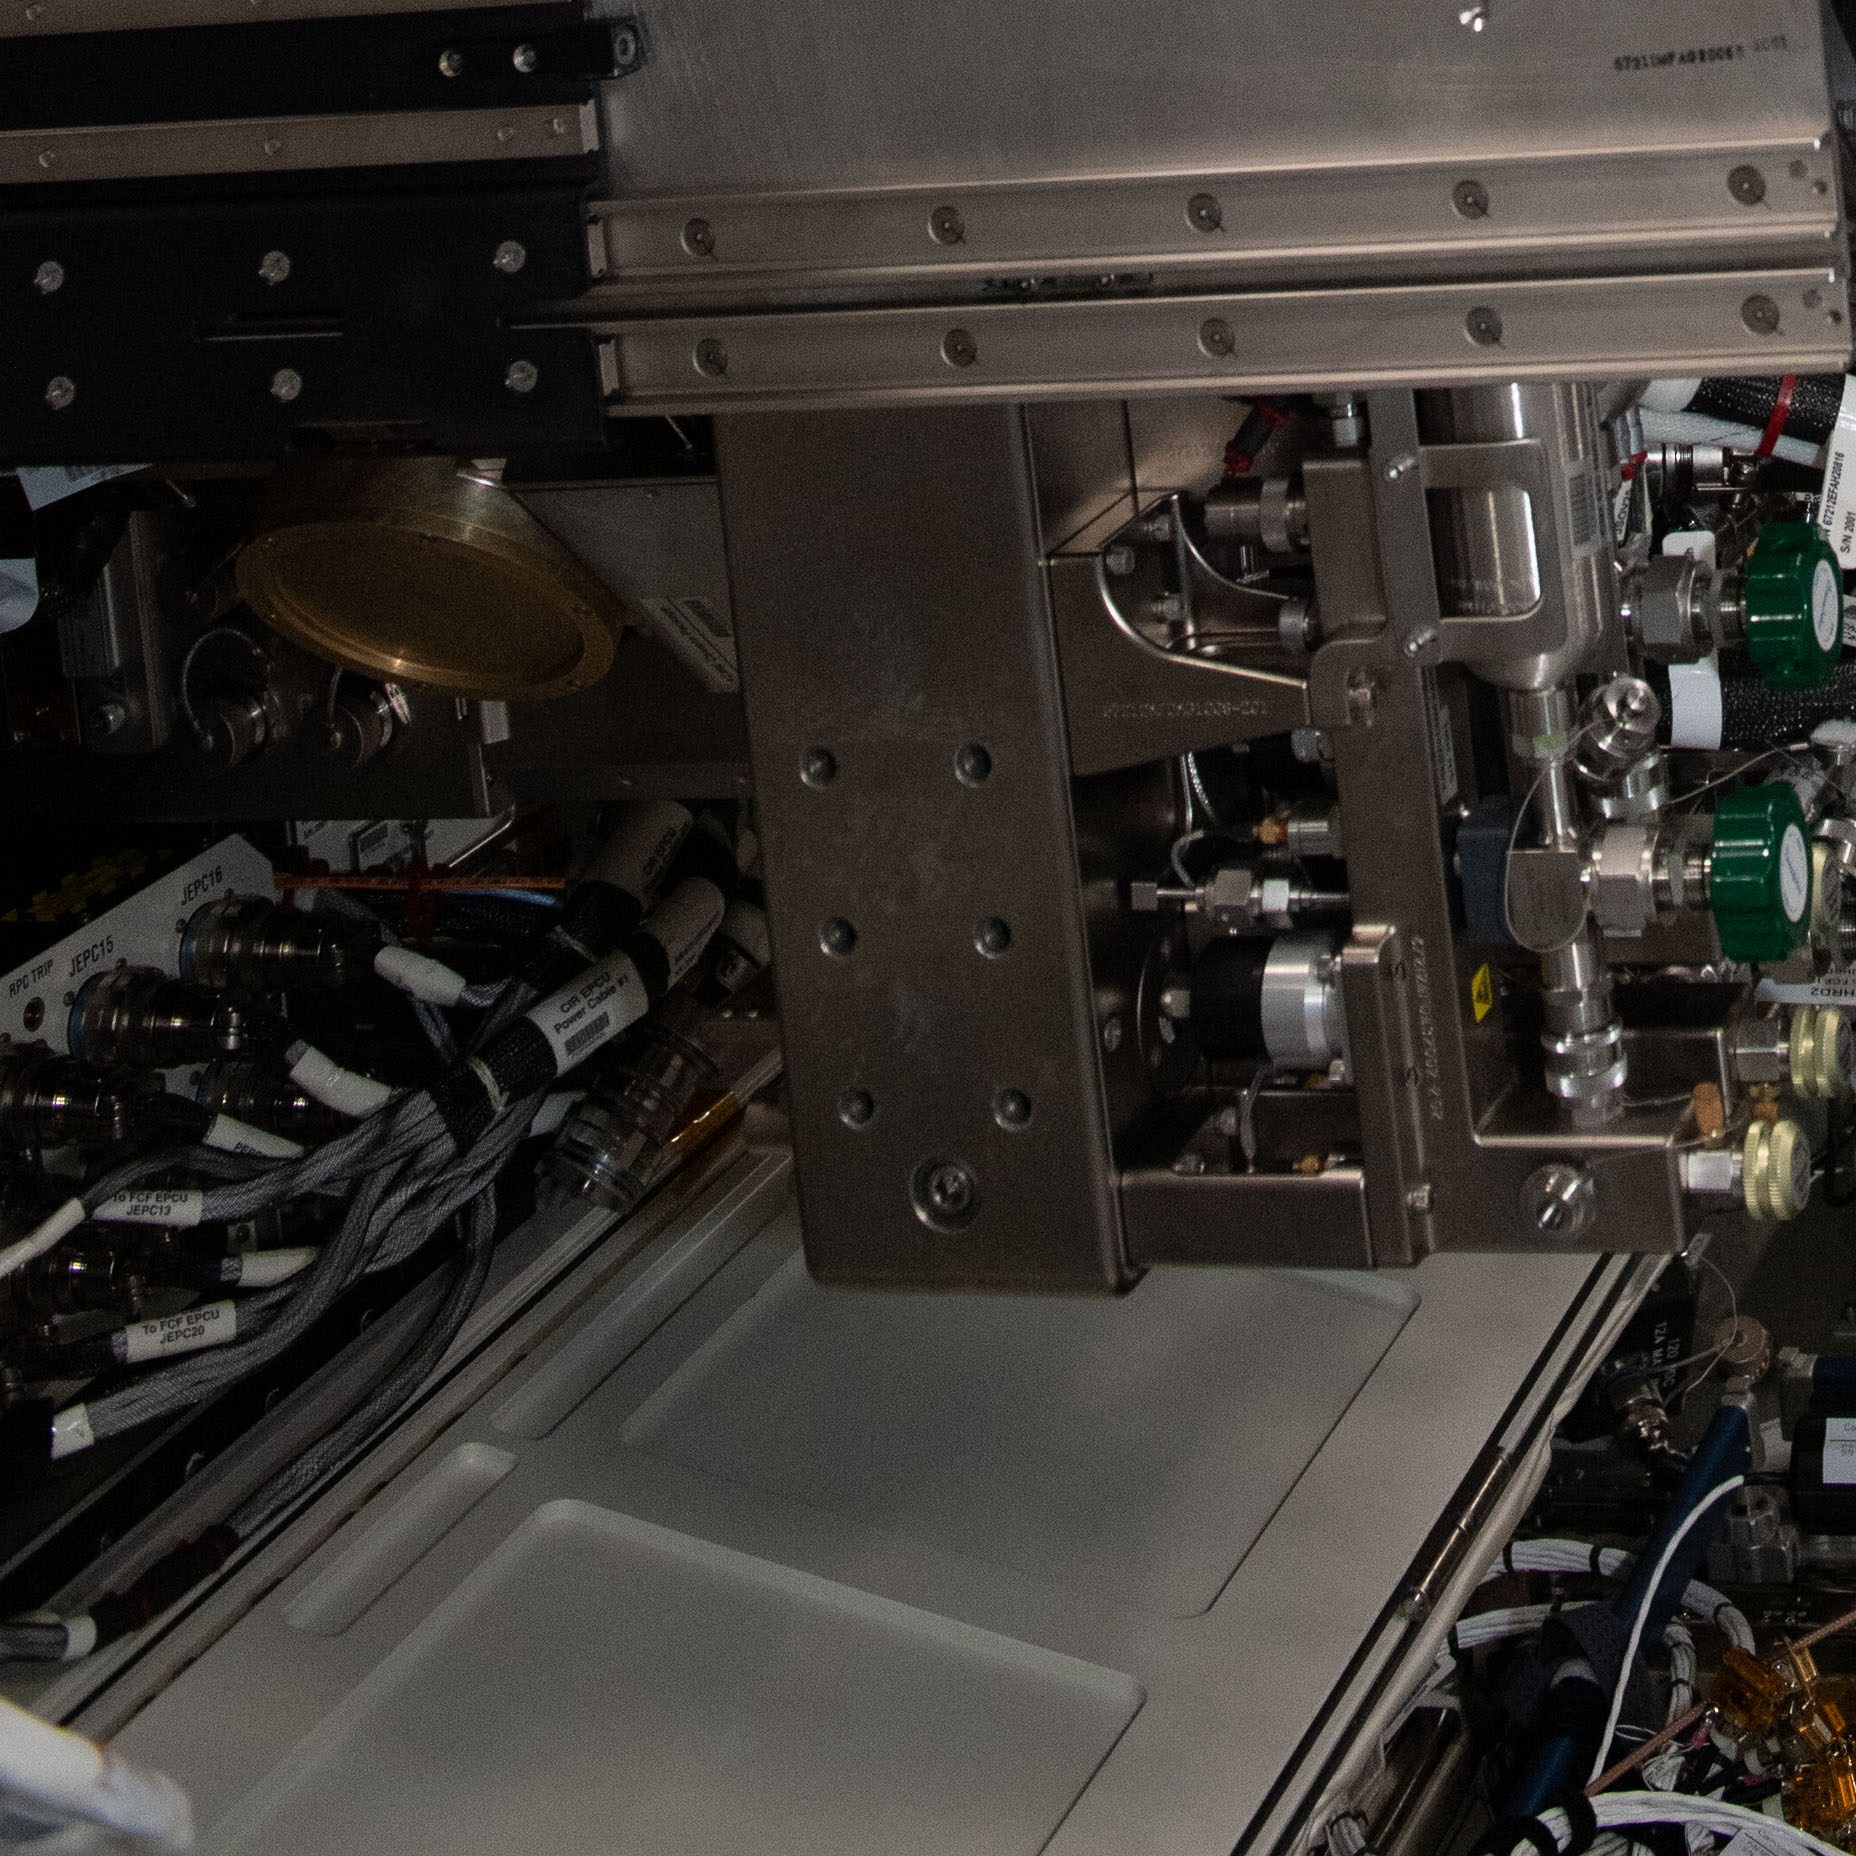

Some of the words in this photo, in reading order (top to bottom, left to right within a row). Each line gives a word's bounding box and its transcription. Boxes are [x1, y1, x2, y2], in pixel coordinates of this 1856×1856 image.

[1843, 510, 1856, 532] 2001
[1839, 534, 1852, 553] S/N
[174, 865, 228, 907] JEPC16
[61, 933, 118, 978] JEPC15
[3, 972, 34, 999] RPC
[27, 956, 60, 984] TRIP
[557, 993, 583, 1015] CIR
[577, 971, 614, 999] EPCU
[550, 1004, 590, 1036] Power
[583, 982, 620, 1012] Cable
[128, 1191, 154, 1203] FCF
[154, 1191, 188, 1203] EPCU
[125, 1204, 171, 1217] JEPC13
[141, 1322, 157, 1334] To
[158, 1317, 183, 1331] FCF
[185, 1309, 220, 1326] EPCU
[1649, 1320, 1671, 1344] 12A
[158, 1324, 206, 1344] JEPC20
